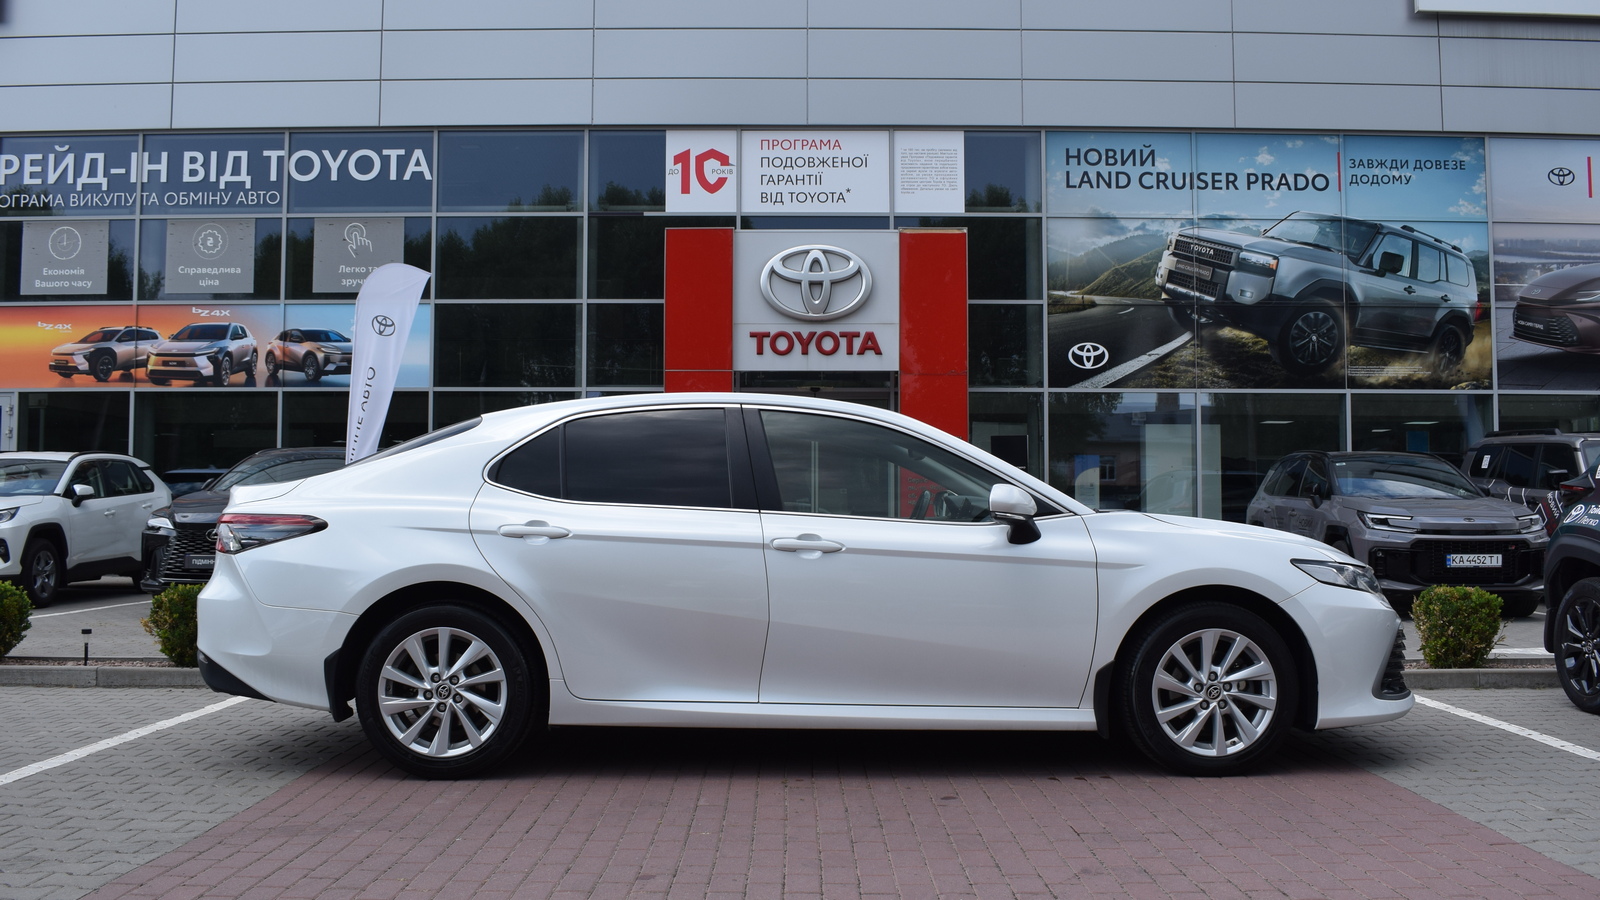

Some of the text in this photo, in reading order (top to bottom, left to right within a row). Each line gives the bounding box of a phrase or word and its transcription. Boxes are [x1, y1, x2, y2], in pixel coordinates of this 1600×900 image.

[760, 139, 842, 150] ПРОГРАМА
[1065, 144, 1156, 166] НОВИЙ
[760, 154, 869, 170] ПОДОВЖЕНОЇ
[1349, 159, 1466, 172] ЗАВЖДИ ДОВЕЗЕ
[183, 150, 251, 190] ВІД
[263, 149, 434, 182] TOYOTA
[668, 168, 680, 176] ДО
[711, 167, 734, 175] РОКІВ
[760, 172, 824, 186] ГАРАНТІЇ
[1065, 171, 1330, 191] LAND CRUISER PRADO
[1349, 174, 1412, 186] ДОДОМУ
[69, 192, 136, 207] ВИКУПУ
[142, 192, 160, 206] ТА
[164, 191, 232, 206] ОБМІНУ
[236, 191, 280, 205] АВТО
[760, 192, 785, 205] ВІД
[1190, 244, 1214, 255] TOYOTA
[42, 266, 85, 276] Економія
[178, 266, 241, 276] Справедлива
[338, 265, 366, 273] Легко
[35, 279, 92, 288] Вашого часу
[199, 278, 219, 287] ціна
[749, 330, 883, 356] TOYOTA
[1578, 515, 1599, 526] Легко
[1451, 555, 1464, 564] KA
[1466, 555, 1487, 564] 4452
